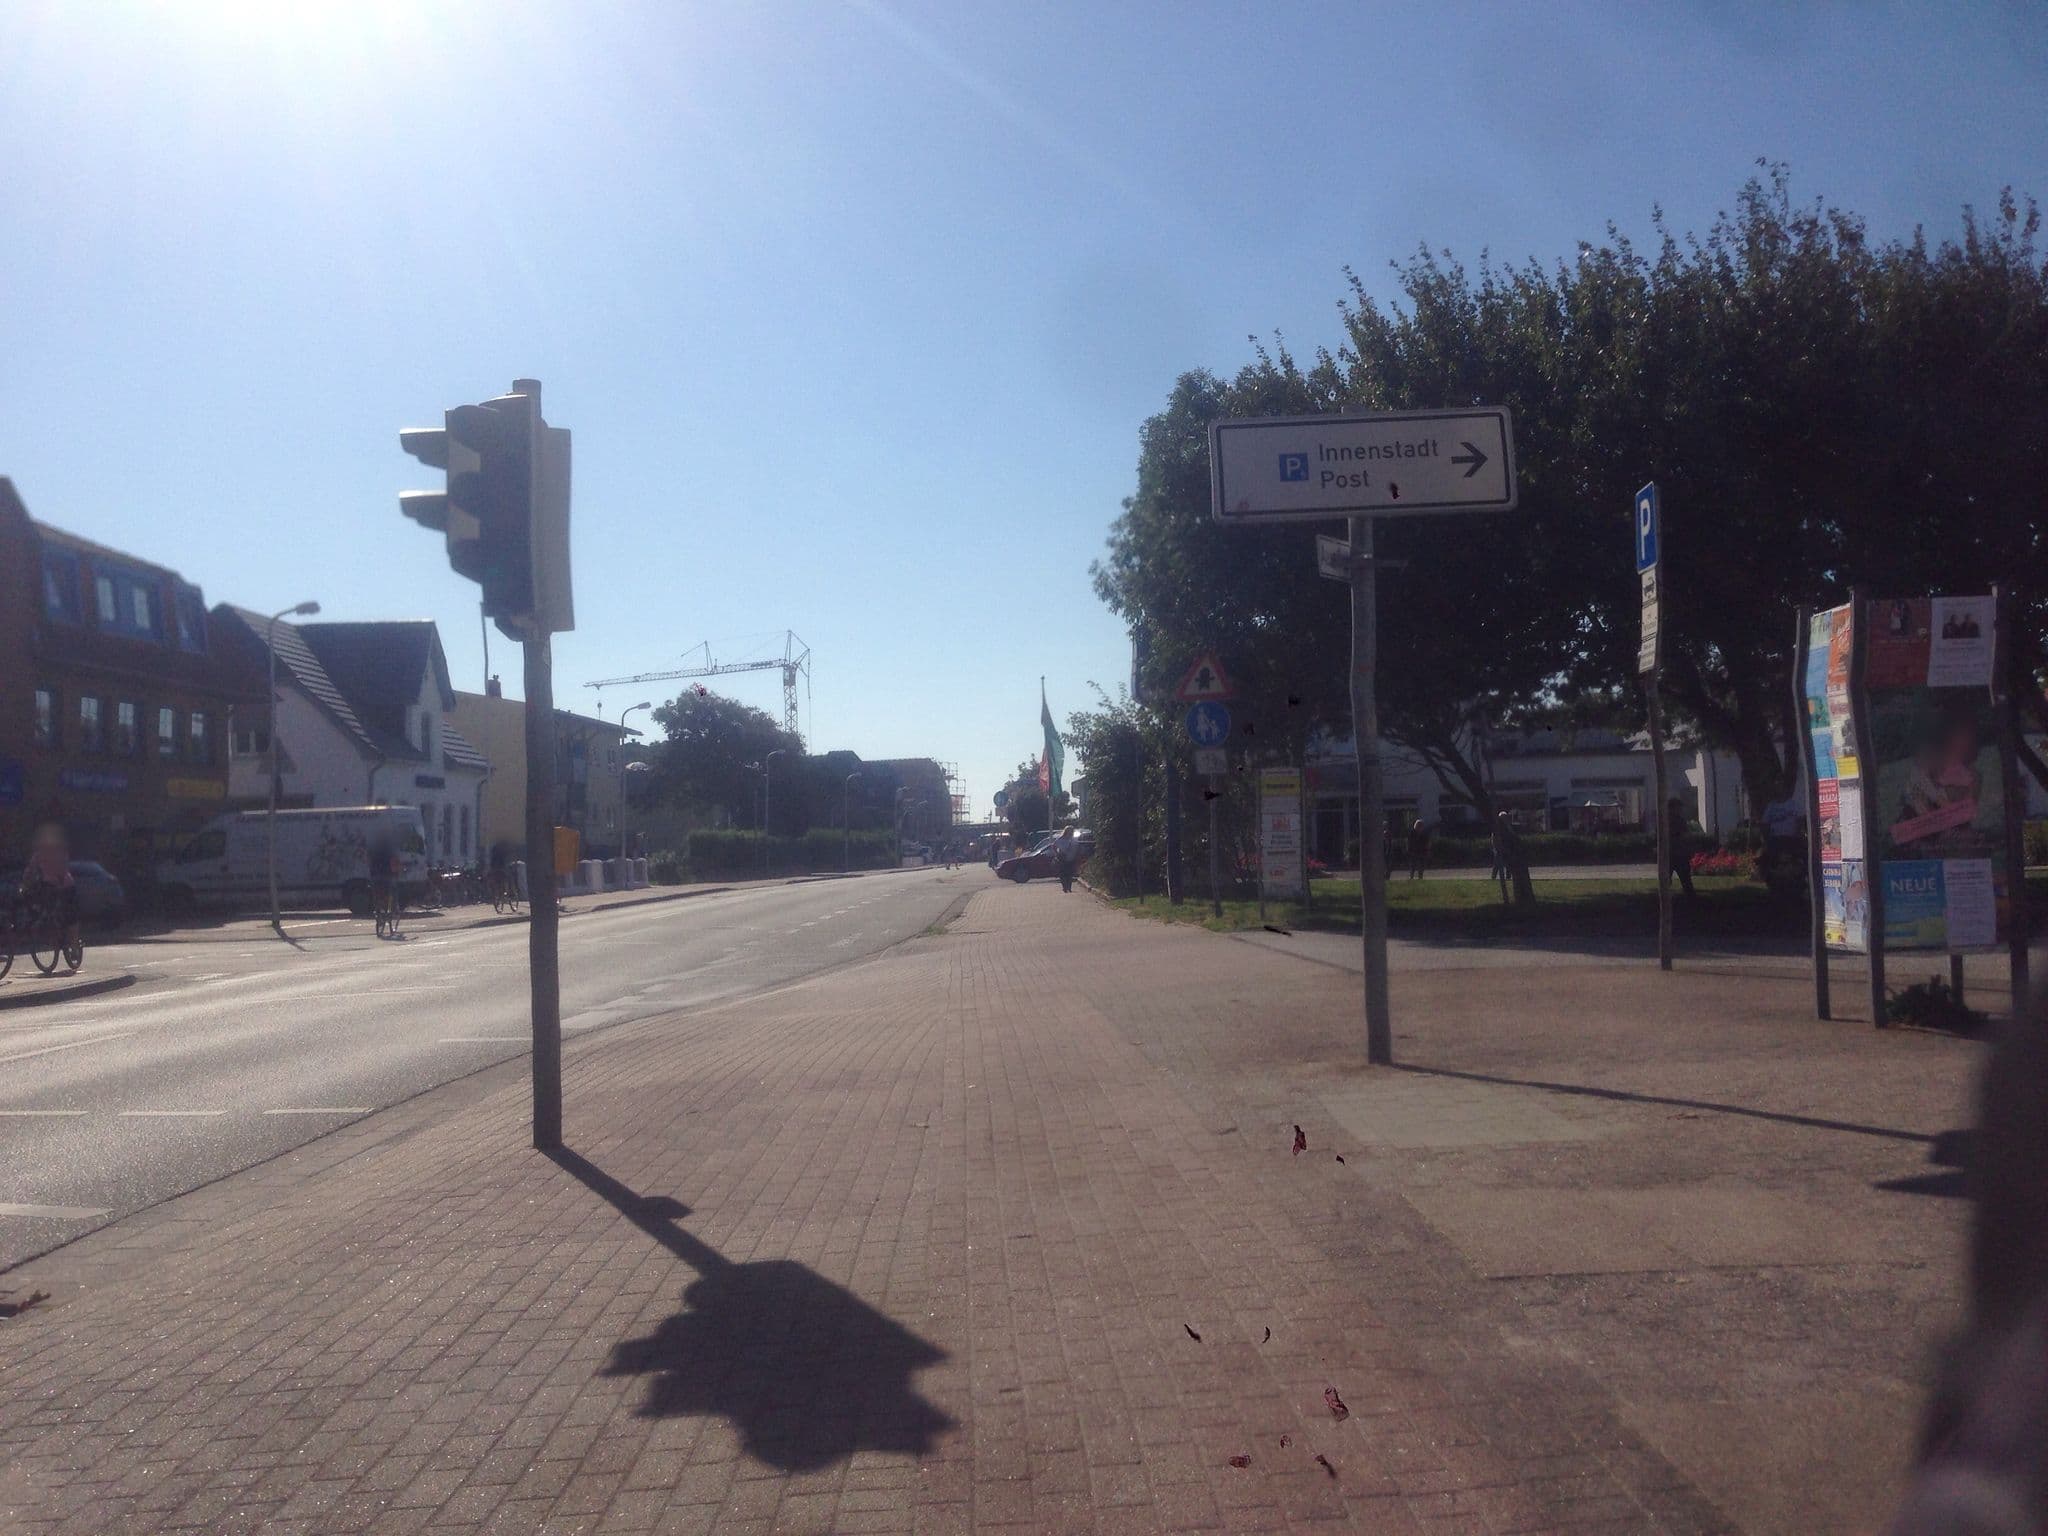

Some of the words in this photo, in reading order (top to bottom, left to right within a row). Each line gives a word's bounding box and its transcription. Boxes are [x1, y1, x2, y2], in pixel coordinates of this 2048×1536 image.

[1319, 438, 1439, 461] Innenstadt
[1285, 457, 1301, 479] P
[1321, 470, 1370, 488] Post
[1640, 497, 1651, 561] P
[1890, 877, 1937, 892] NEUE
